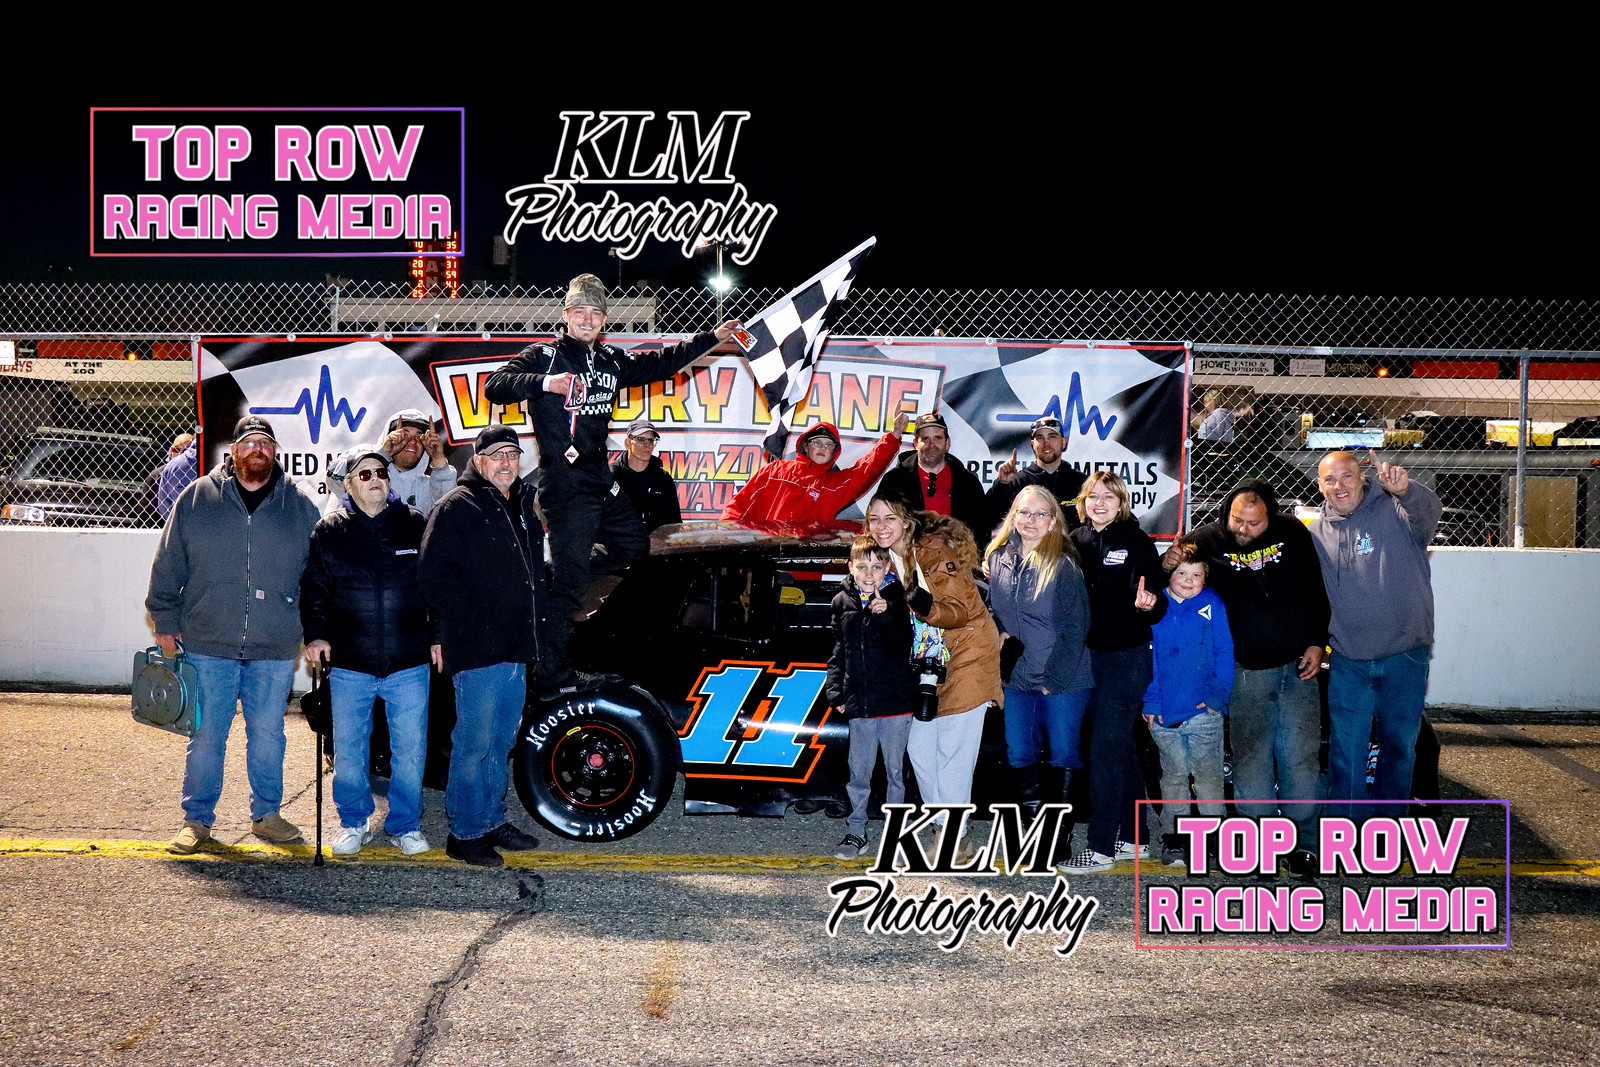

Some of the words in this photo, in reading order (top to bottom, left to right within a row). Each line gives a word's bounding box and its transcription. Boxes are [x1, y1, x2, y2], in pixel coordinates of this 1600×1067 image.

[446, 241, 457, 249] 35
[412, 259, 423, 268] 28
[446, 260, 457, 269] 31
[412, 269, 423, 278] 99
[446, 270, 457, 279] 59
[418, 279, 423, 288] 2
[446, 280, 457, 289] 41
[412, 289, 423, 298] 25
[450, 289, 456, 299] 2
[0, 360, 33, 373] DAYS
[1200, 360, 1230, 371] HOWE
[449, 365, 737, 430] VORY
[678, 666, 828, 768] 11
[525, 700, 597, 751] Hoosier
[585, 788, 657, 838] Hoosier
